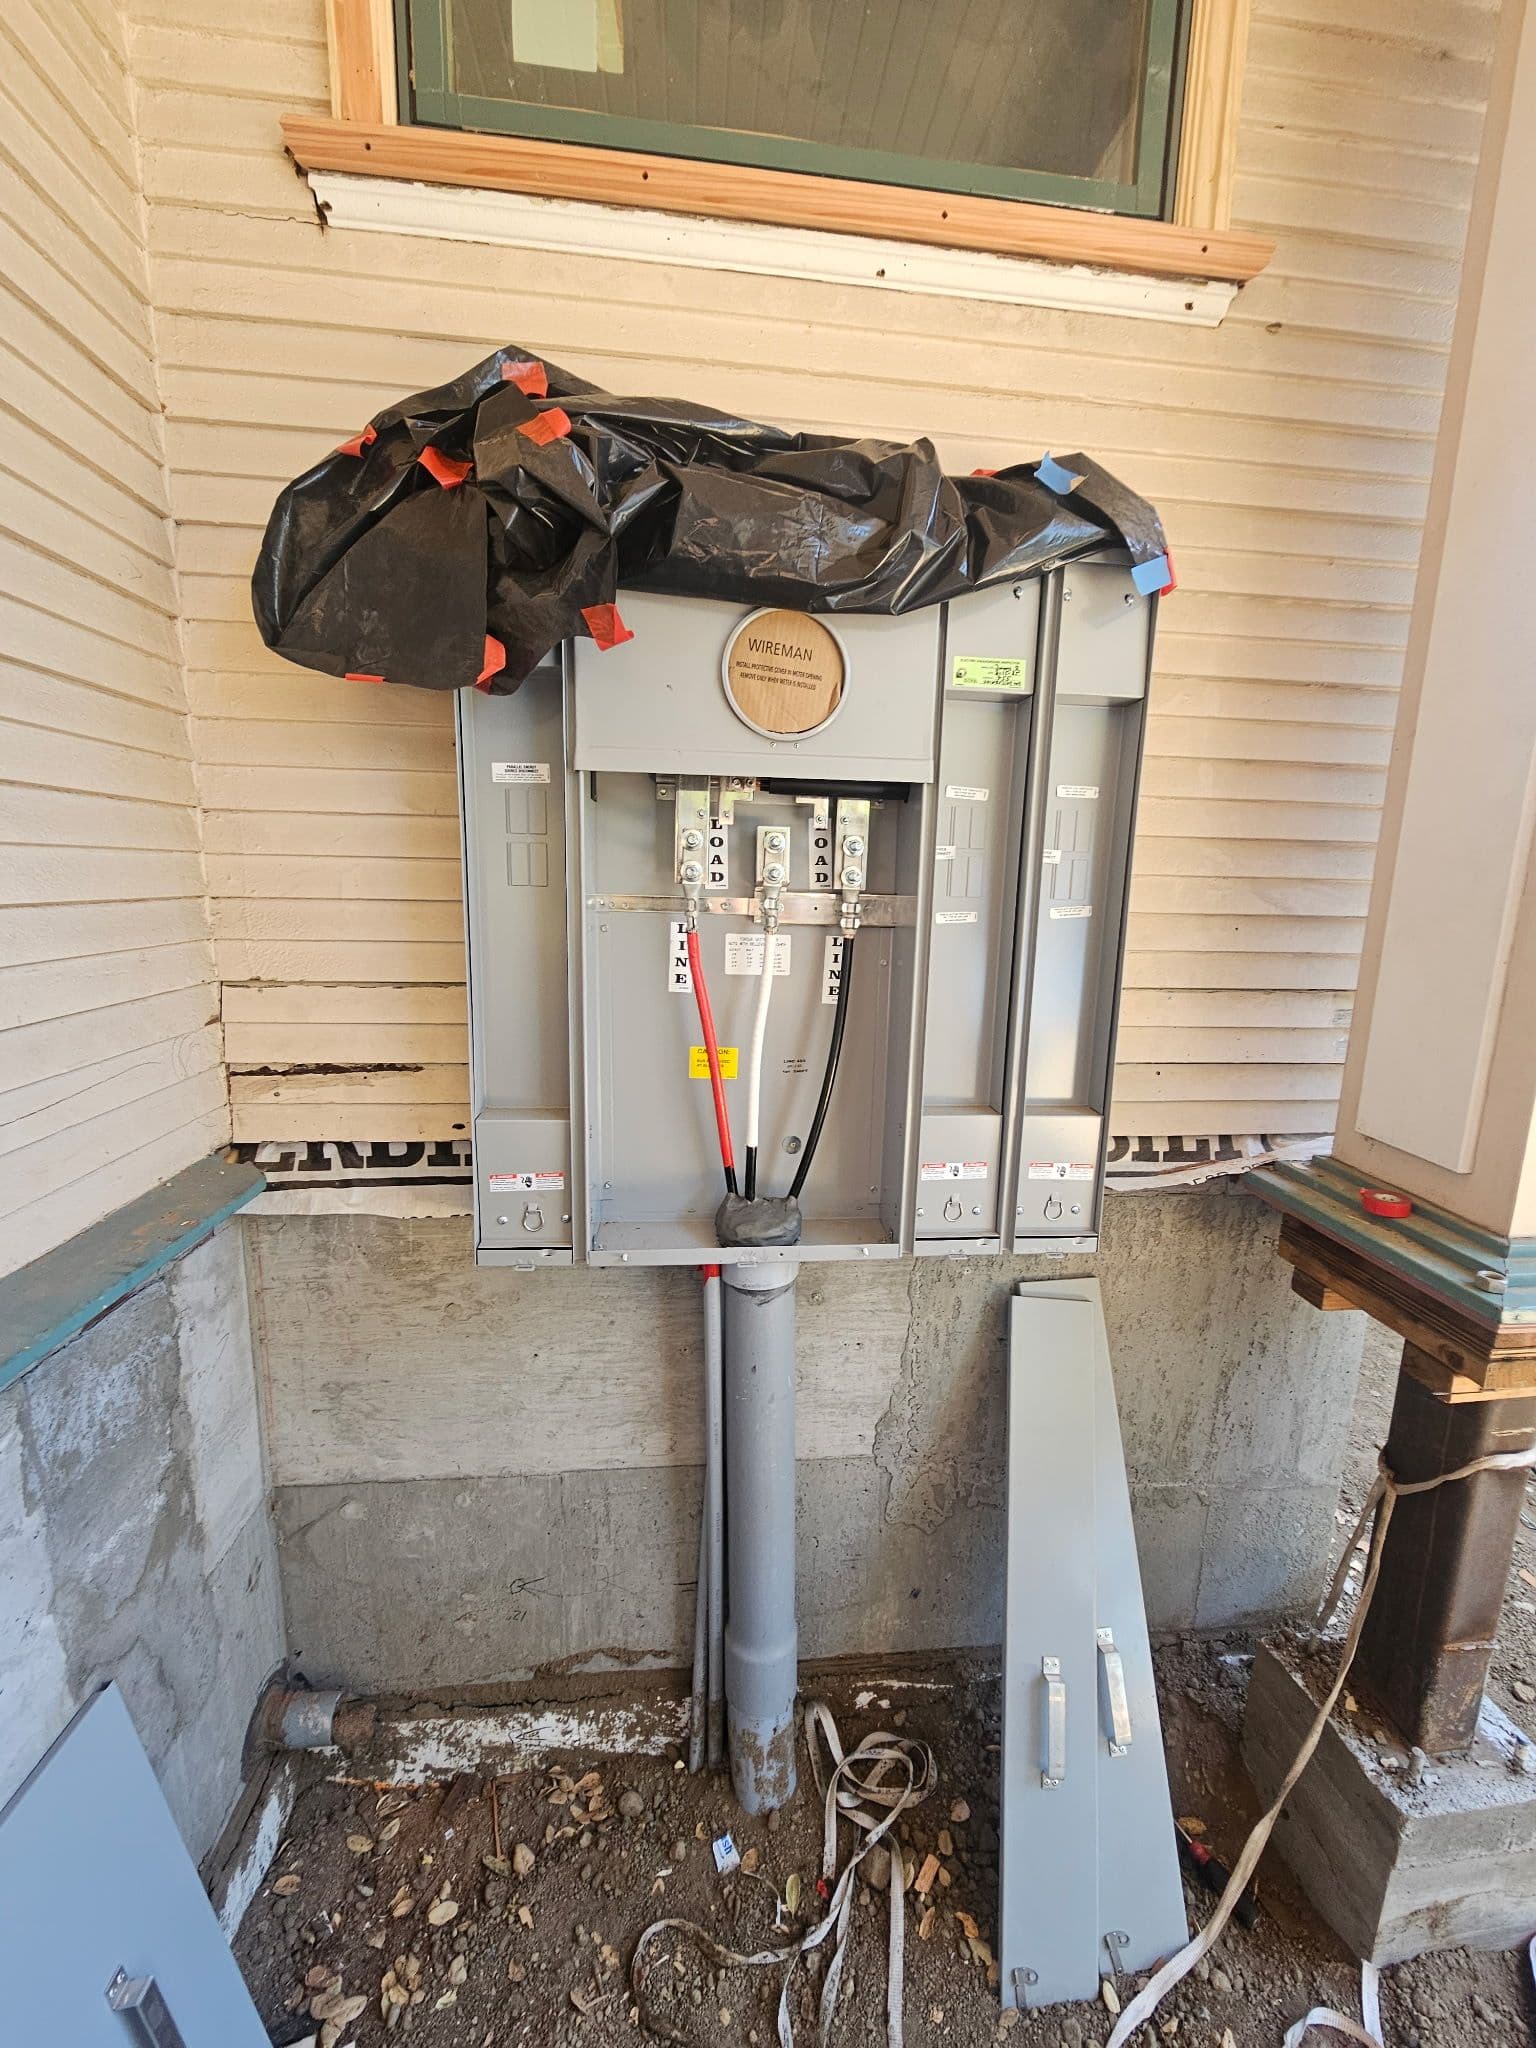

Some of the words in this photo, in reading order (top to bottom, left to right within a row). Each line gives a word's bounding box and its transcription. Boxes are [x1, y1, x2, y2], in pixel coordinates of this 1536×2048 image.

[748, 637, 813, 662] WIREMAN
[752, 663, 774, 673] PROTECTIVE
[774, 666, 787, 675] COVER
[740, 671, 756, 680] REMOVE
[756, 674, 767, 682] ONLY
[768, 676, 779, 684] WHEN
[779, 678, 792, 686] METER
[710, 819, 725, 882] LOAD
[814, 828, 829, 883] OAD
[675, 924, 688, 984] LINE
[829, 937, 843, 996] LINE
